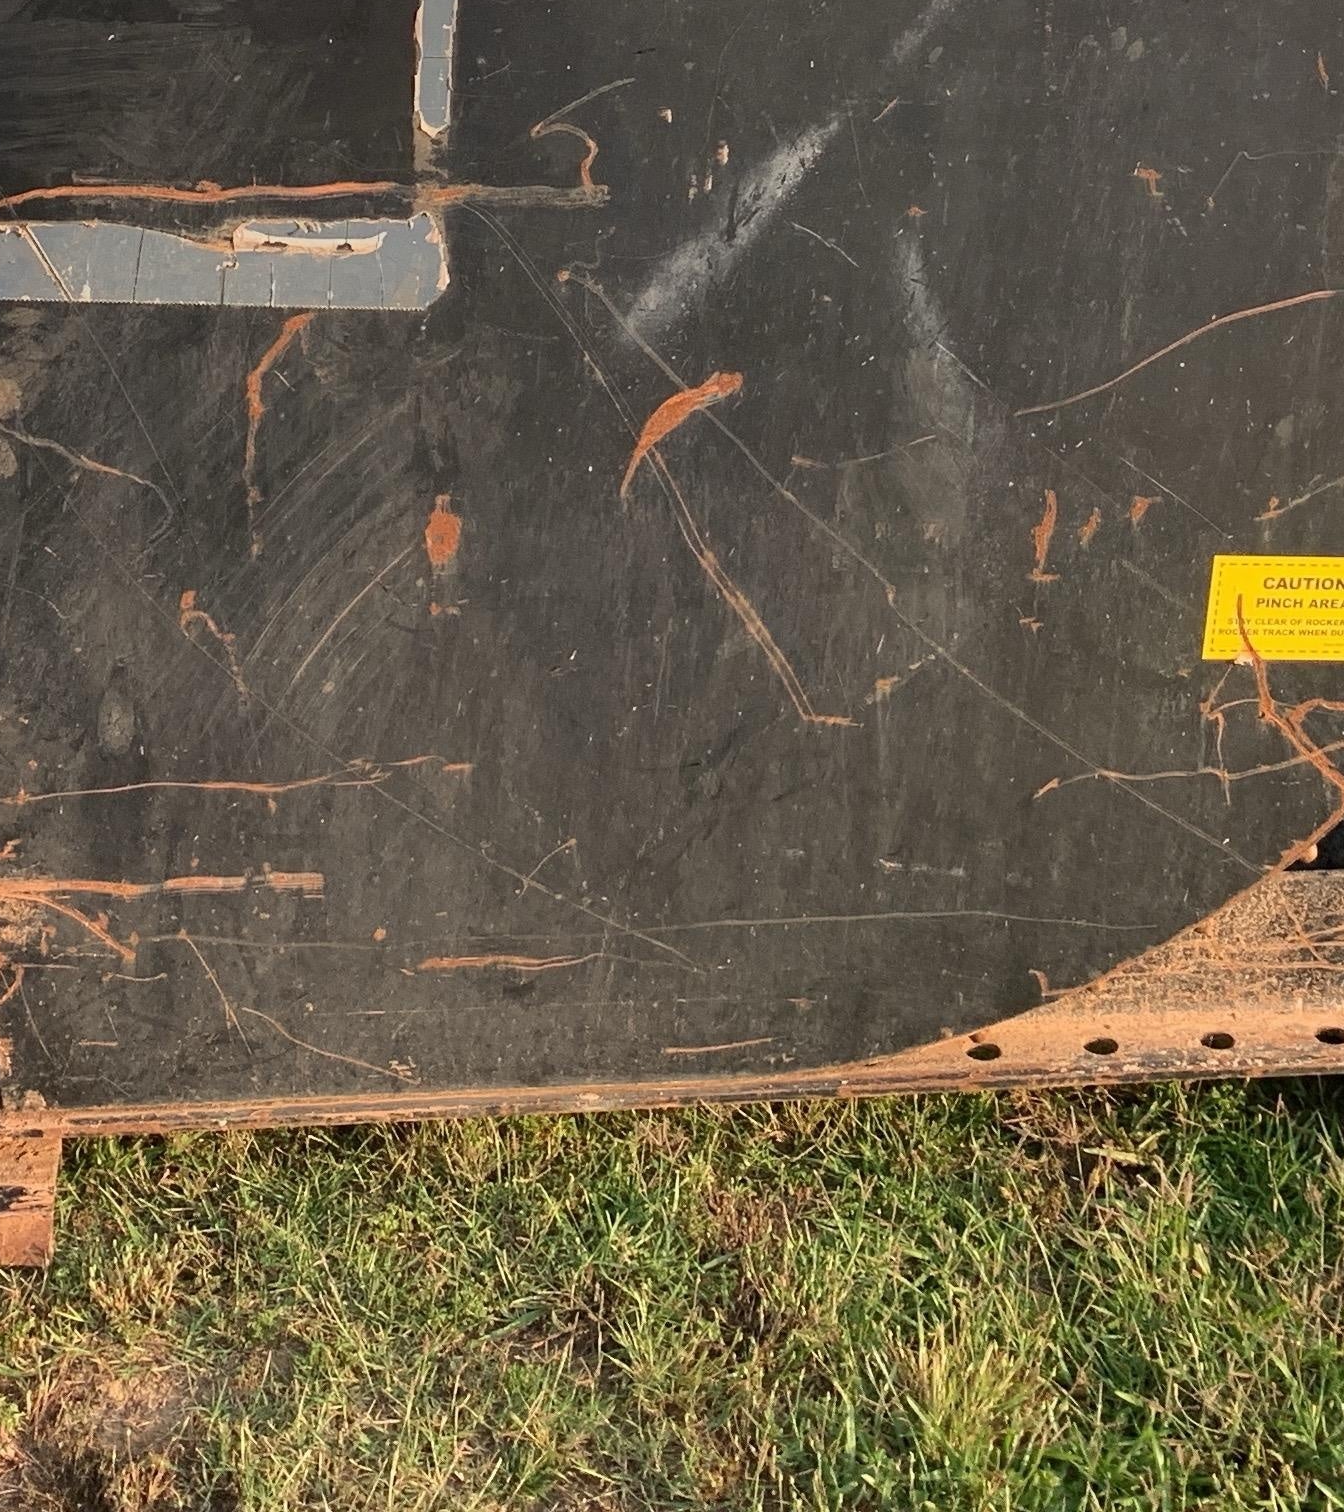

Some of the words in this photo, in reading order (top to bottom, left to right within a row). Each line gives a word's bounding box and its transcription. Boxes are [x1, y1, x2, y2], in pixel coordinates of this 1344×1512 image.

[1256, 597, 1305, 609] PINCH
[1256, 617, 1287, 626] CLEAR
[1290, 618, 1303, 626] OF
[1218, 628, 1261, 636] ROCER
[1262, 628, 1295, 637] TRACK
[1298, 628, 1328, 637] WHEN
